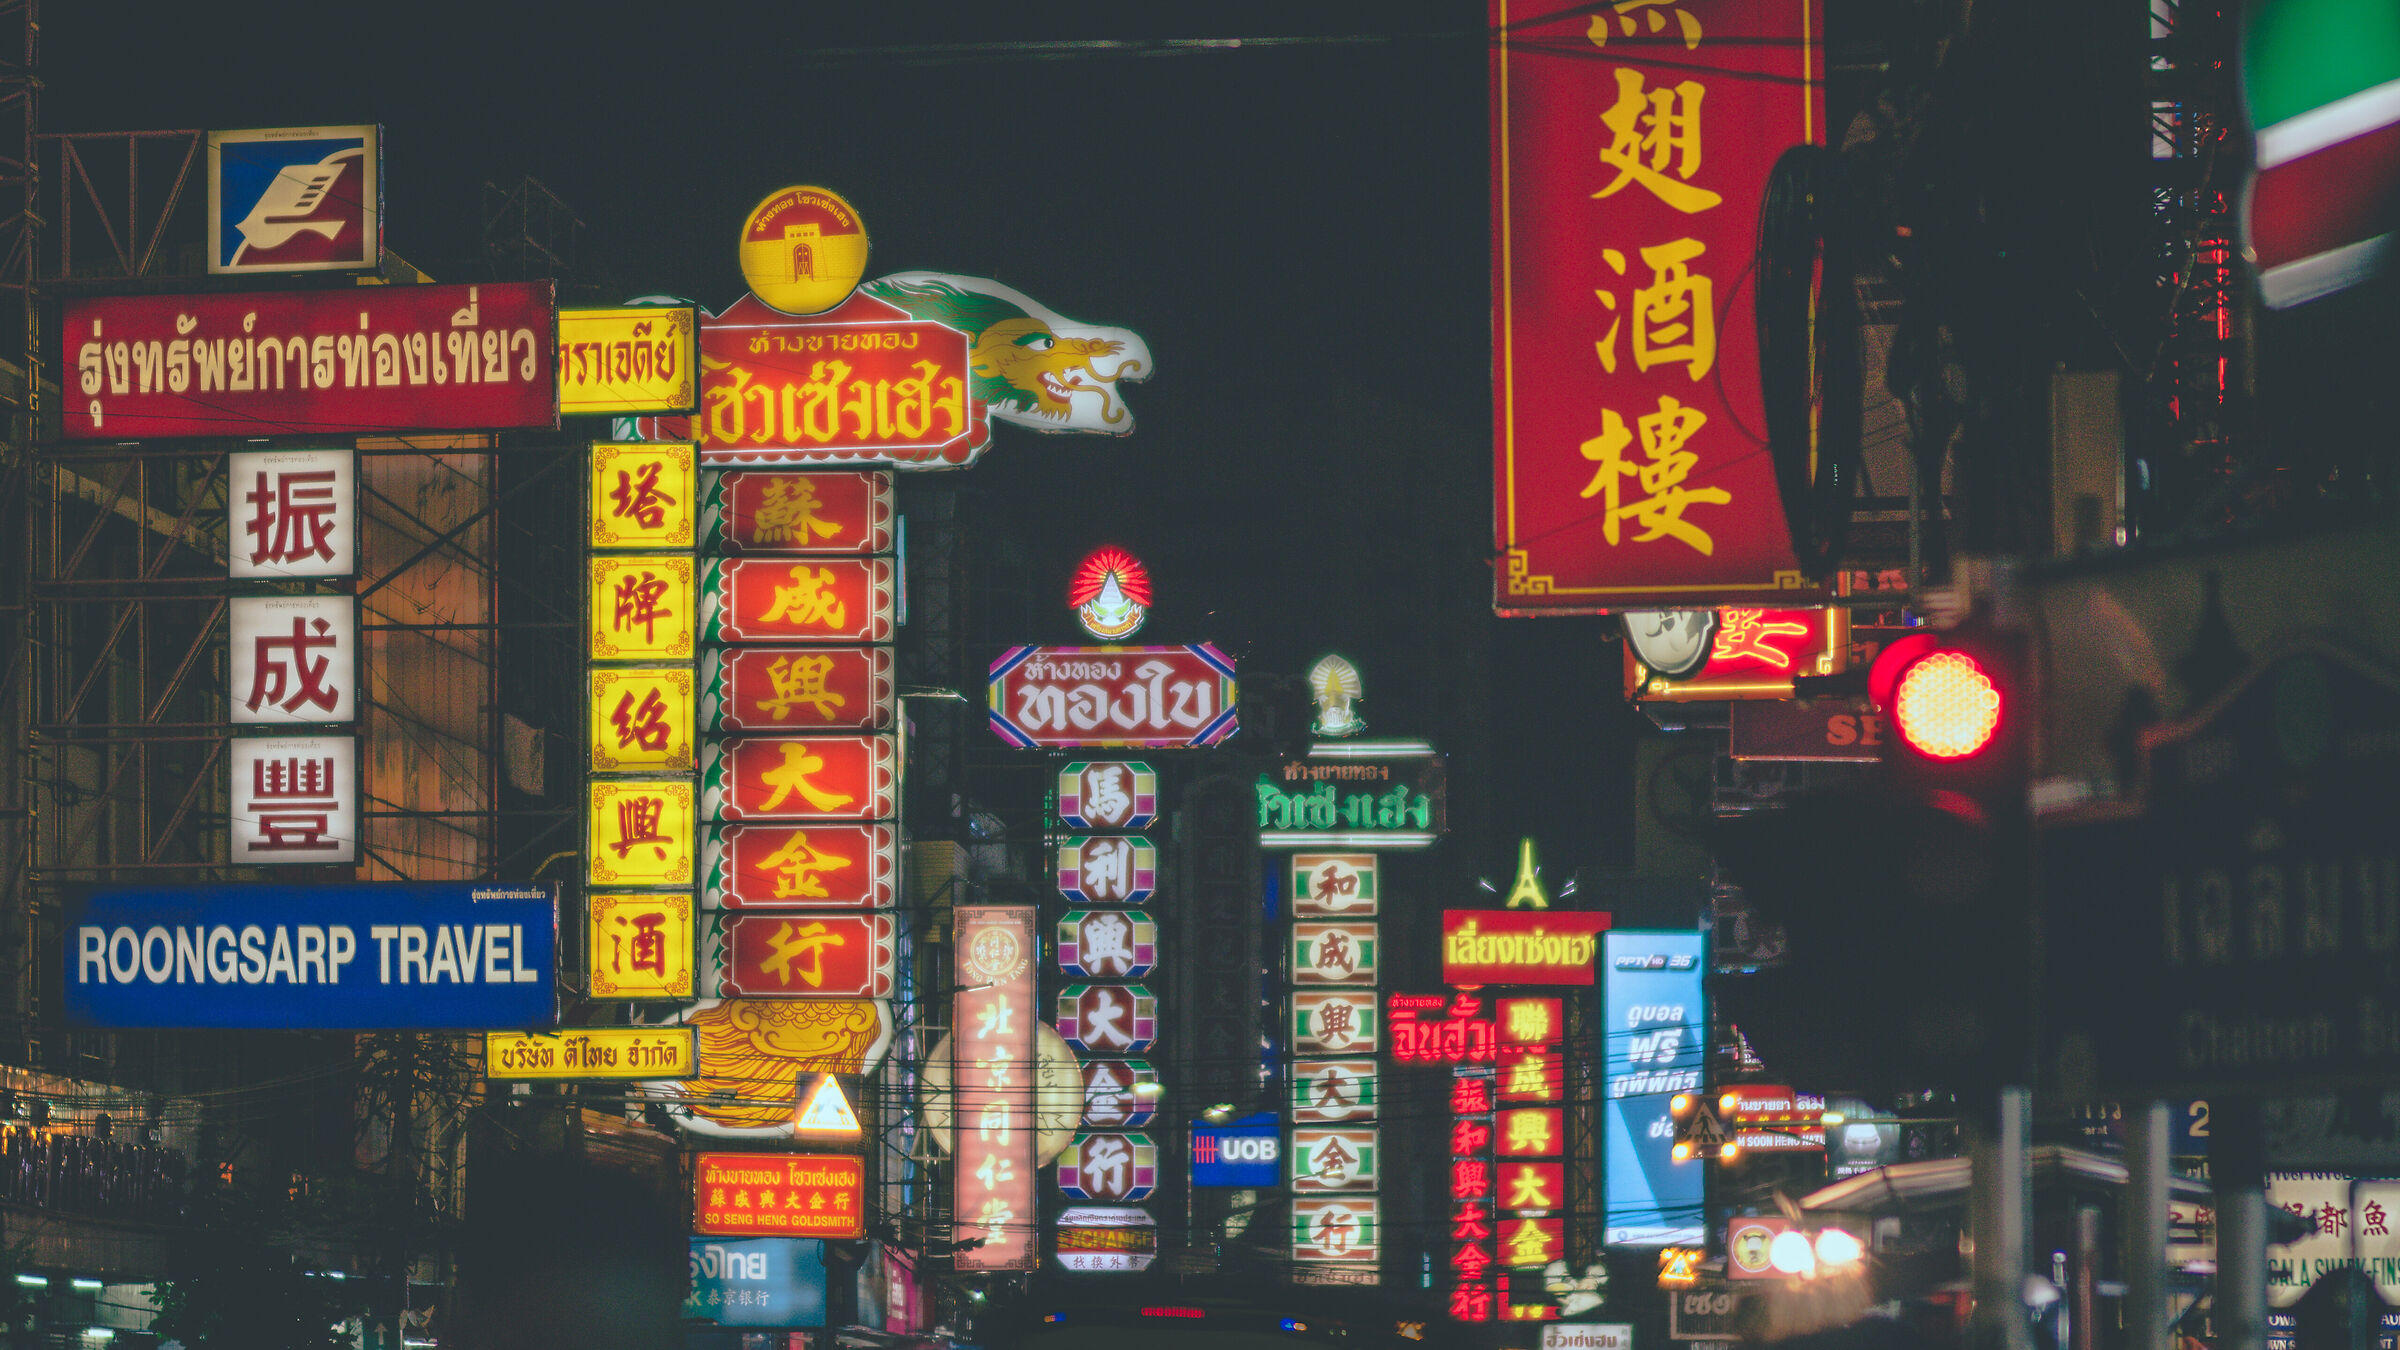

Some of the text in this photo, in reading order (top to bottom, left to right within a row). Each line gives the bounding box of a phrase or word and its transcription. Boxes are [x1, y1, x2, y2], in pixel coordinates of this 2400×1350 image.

[756, 198, 794, 232] ห้างทอง
[749, 330, 919, 354] ห้างขายทอง
[78, 287, 536, 428] รุ่งทรัพย์การท่องเที่ยว
[1025, 655, 1122, 680] ห้างทอง
[1283, 761, 1389, 781] ห้างขายทอง
[78, 925, 538, 985] ROONGSARP TRAVEL
[1447, 920, 1595, 966] เลี่ยงเซ่งเฮ
[1670, 955, 1691, 967] 36
[1628, 1005, 1684, 1029] ดูบอล
[501, 1039, 554, 1069] บริษัท
[627, 1038, 677, 1068] จำกัด
[1629, 1028, 1683, 1064] ฟรี
[975, 994, 1014, 1245] 北京同仁堂
[1223, 1139, 1276, 1161] UOB
[1747, 1135, 1773, 1147] SOON
[1508, 1002, 1553, 1318] 聯成興大金
[705, 1164, 780, 1185] ห้างขายทอง
[705, 1213, 855, 1228] SO SENG HENG GOLDSMITH
[1057, 1229, 1153, 1249] EXCHANGE
